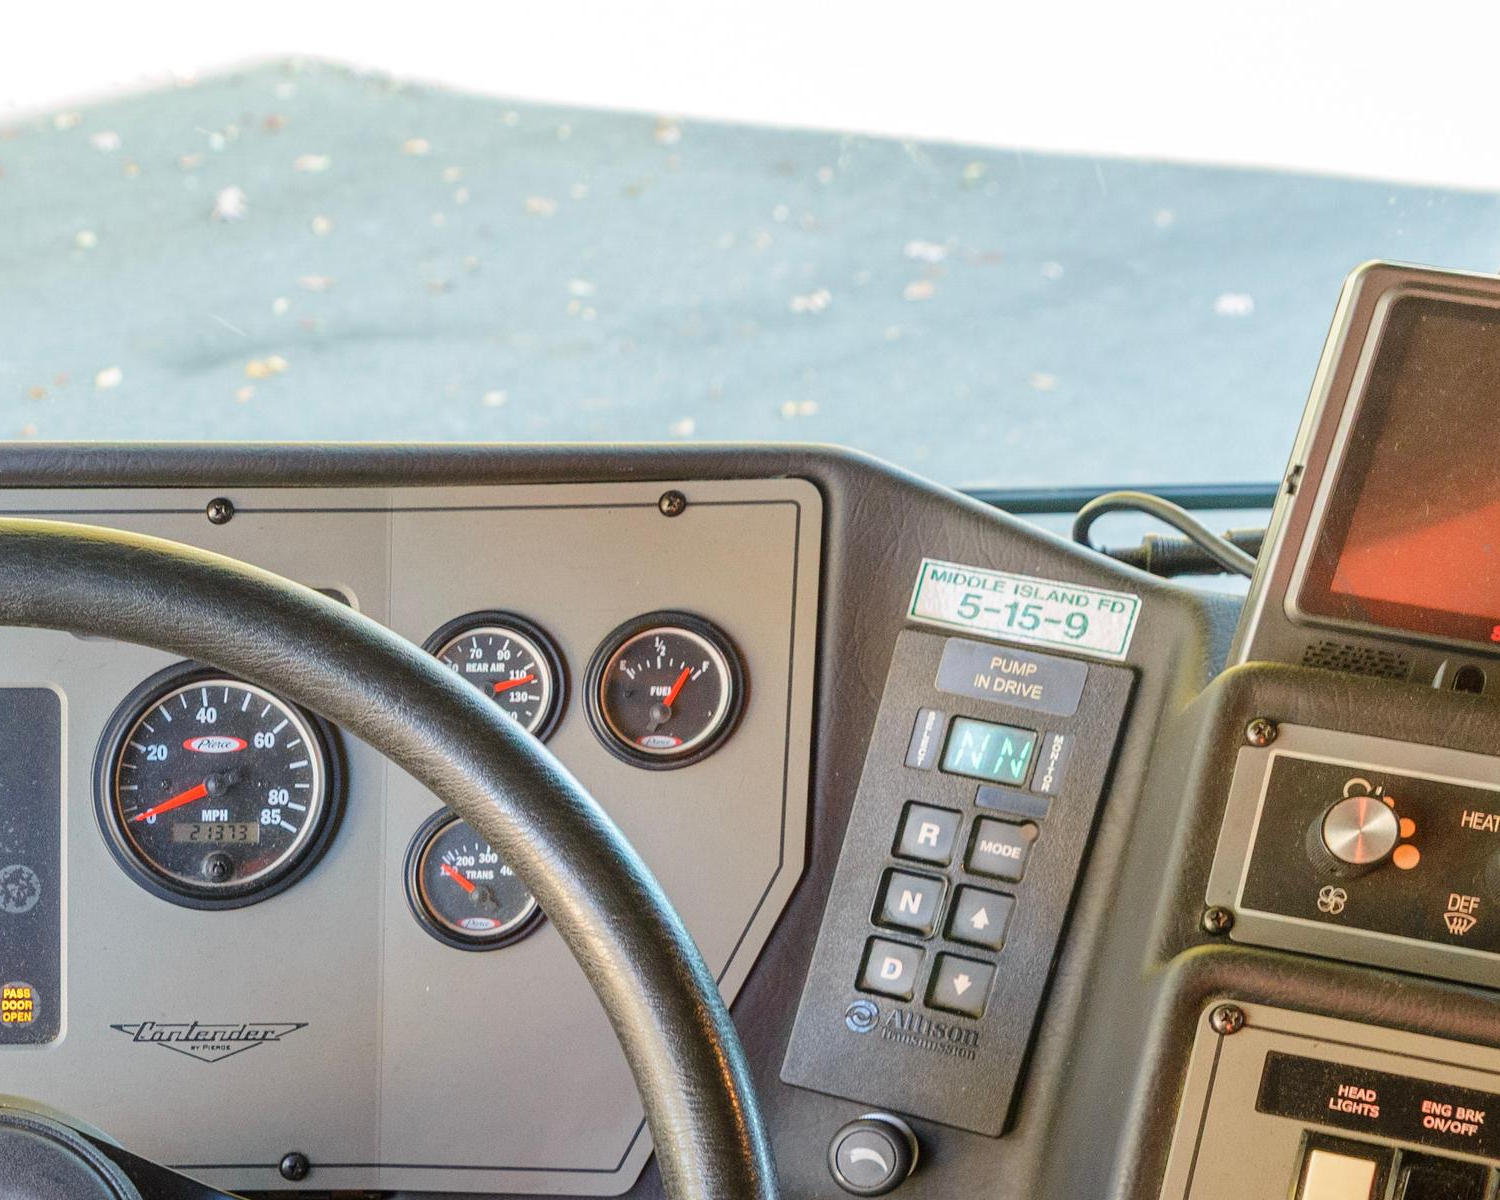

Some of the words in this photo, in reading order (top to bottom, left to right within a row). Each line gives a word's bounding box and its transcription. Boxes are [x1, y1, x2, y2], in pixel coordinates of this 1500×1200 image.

[930, 569, 1005, 595] MIDDLE
[1013, 583, 1090, 608] ISLAND
[1099, 599, 1126, 615] FD
[957, 593, 1090, 640] 5-15-9
[469, 648, 483, 659] 70
[497, 650, 511, 661] 90
[466, 662, 488, 672] REAR
[490, 662, 505, 672] AIR
[702, 661, 710, 673] F
[990, 656, 1038, 677] PUMP
[973, 673, 990, 688] IN
[994, 676, 1043, 700] DRIVE
[509, 692, 528, 702] 130
[196, 707, 218, 725] 40
[253, 732, 275, 749] 60
[146, 744, 168, 761] 20
[1041, 734, 1065, 793] MONITOR
[268, 789, 289, 806] 80
[201, 809, 229, 822] MPH
[260, 808, 281, 826] 85
[189, 826, 248, 841] 21373
[917, 822, 940, 848] R
[479, 852, 498, 864] 300
[980, 839, 1022, 860] MODE
[456, 855, 475, 867] 200
[466, 869, 494, 880] TRANS
[898, 892, 923, 914] N
[1447, 893, 1480, 914] DEF
[880, 958, 904, 980] D
[3, 988, 31, 999] PASS
[1, 1000, 33, 1011] DOOR
[2, 1011, 32, 1022] OPEN
[133, 1021, 280, 1042] Contender
[884, 1008, 980, 1047] Allison
[1338, 1084, 1377, 1103] HEAD
[1329, 1096, 1380, 1118] LIGHTS
[1422, 1100, 1452, 1117] ENG
[1455, 1106, 1485, 1125] BRK
[1423, 1115, 1479, 1137] ON/OFF
